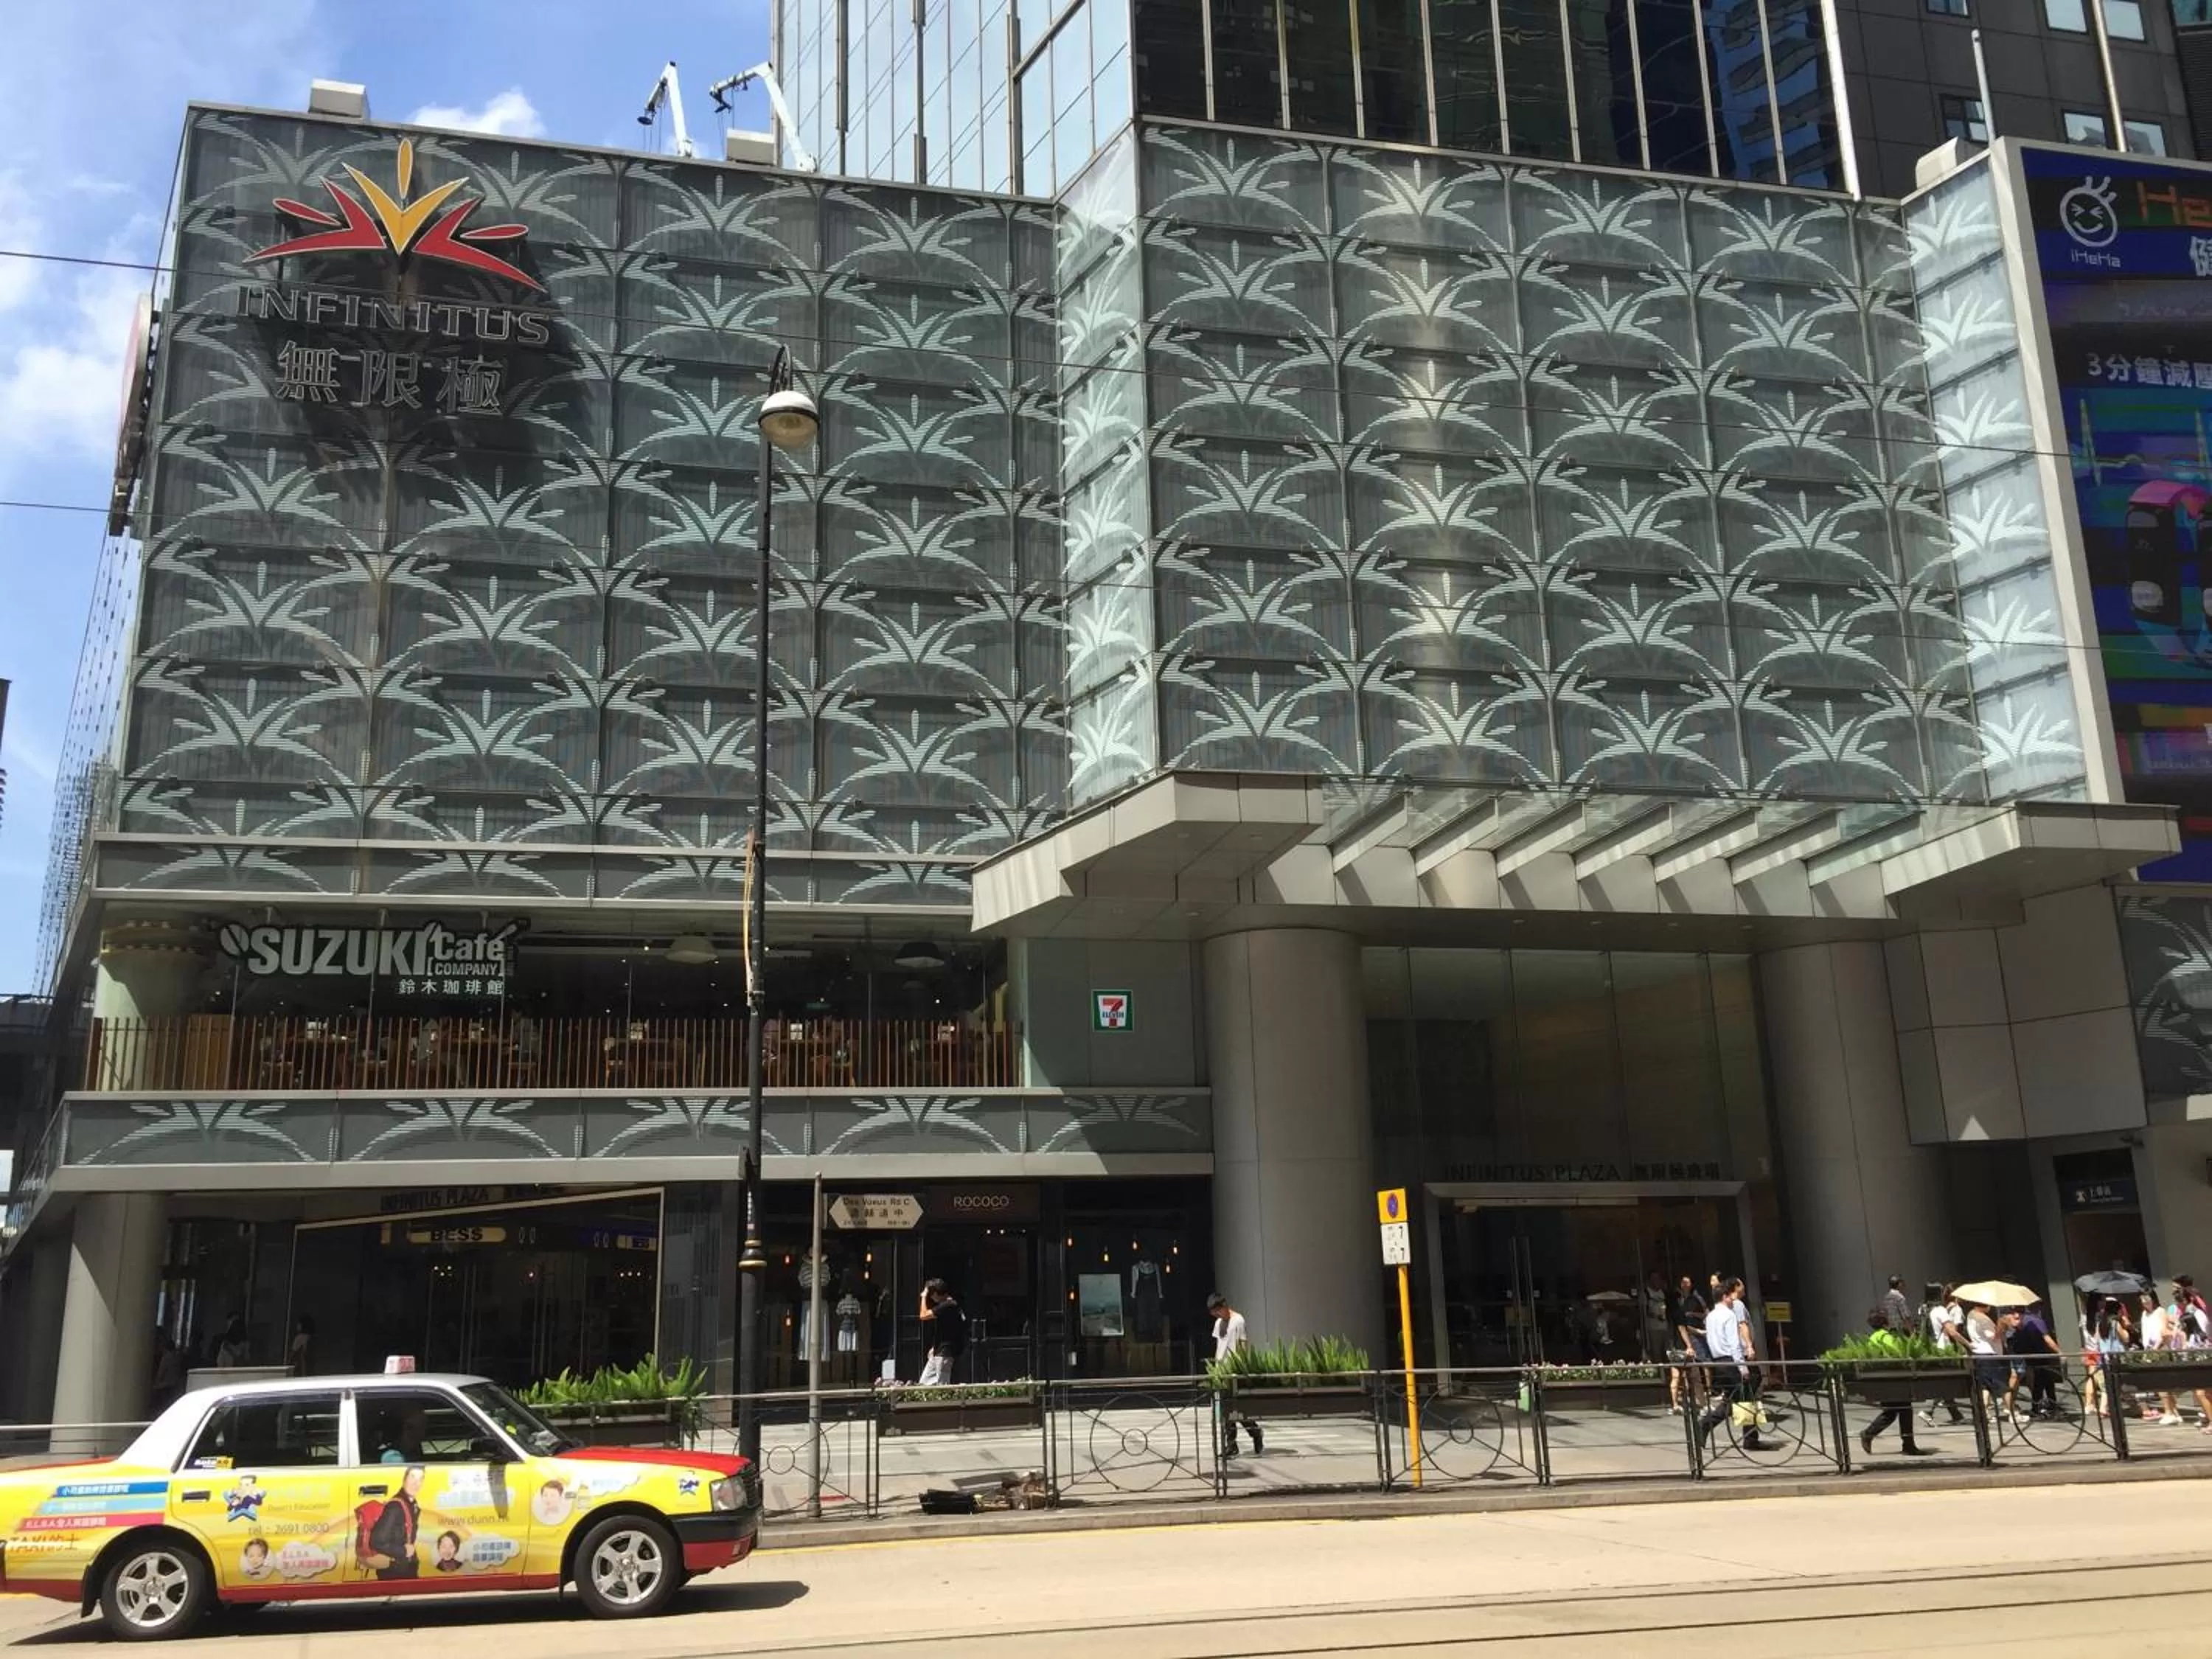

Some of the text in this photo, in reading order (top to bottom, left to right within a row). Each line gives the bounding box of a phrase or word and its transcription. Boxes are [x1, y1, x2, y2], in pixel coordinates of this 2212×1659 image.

[2070, 248, 2121, 268] iHeHa
[237, 285, 549, 344] INFINITUS
[277, 340, 504, 416] 無限極
[248, 923, 516, 975] SUZUKI Café
[434, 962, 498, 976] COMPANY
[399, 978, 503, 995] 鈴木珈琲館
[1102, 998, 1124, 1026] 7
[953, 1195, 1009, 1207] ROCOCO
